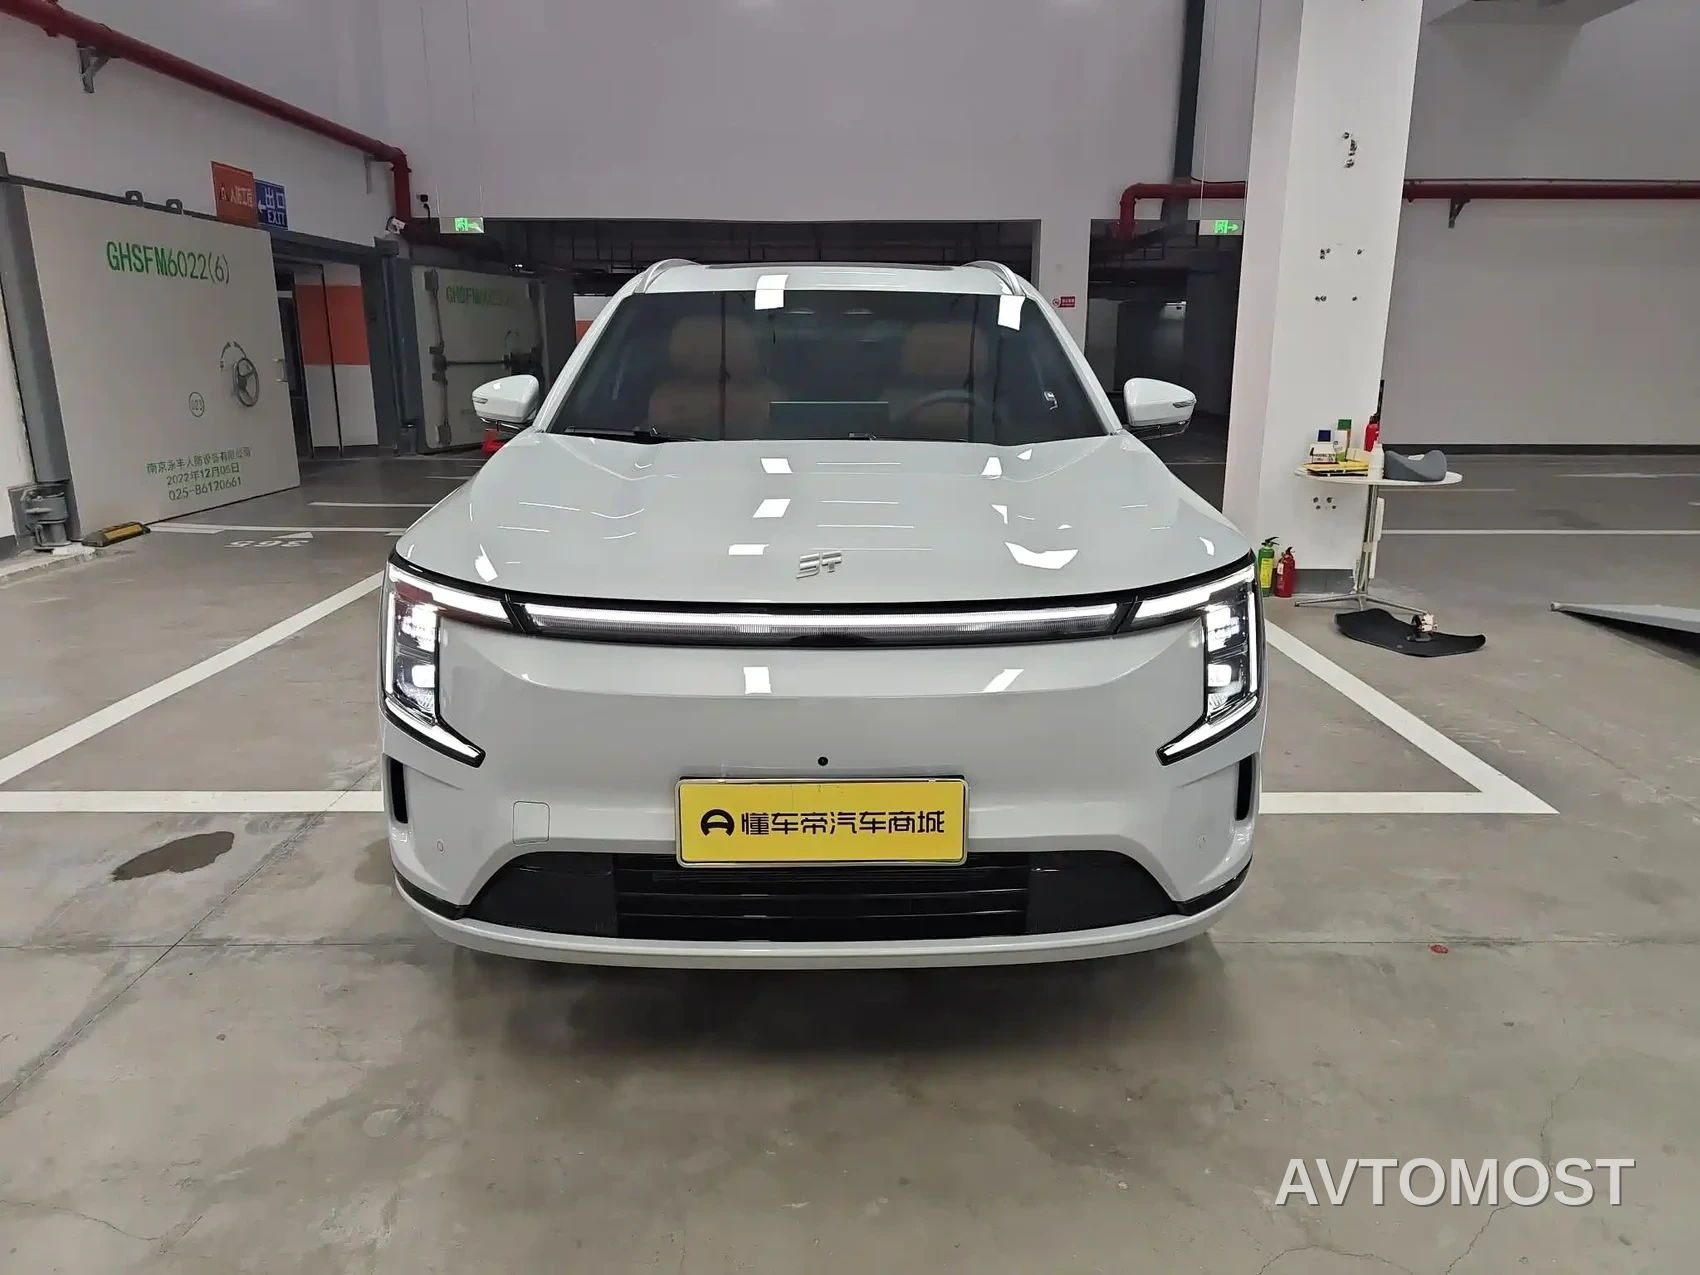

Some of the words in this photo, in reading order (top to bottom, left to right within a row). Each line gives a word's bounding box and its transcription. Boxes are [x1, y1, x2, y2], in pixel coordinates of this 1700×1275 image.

[265, 187, 285, 209] 出口
[267, 209, 285, 226] EXIT
[106, 241, 230, 285] GHSFM6022(6)
[168, 476, 242, 501] 025-86120661
[740, 809, 946, 836] 懂车帝汽车商城
